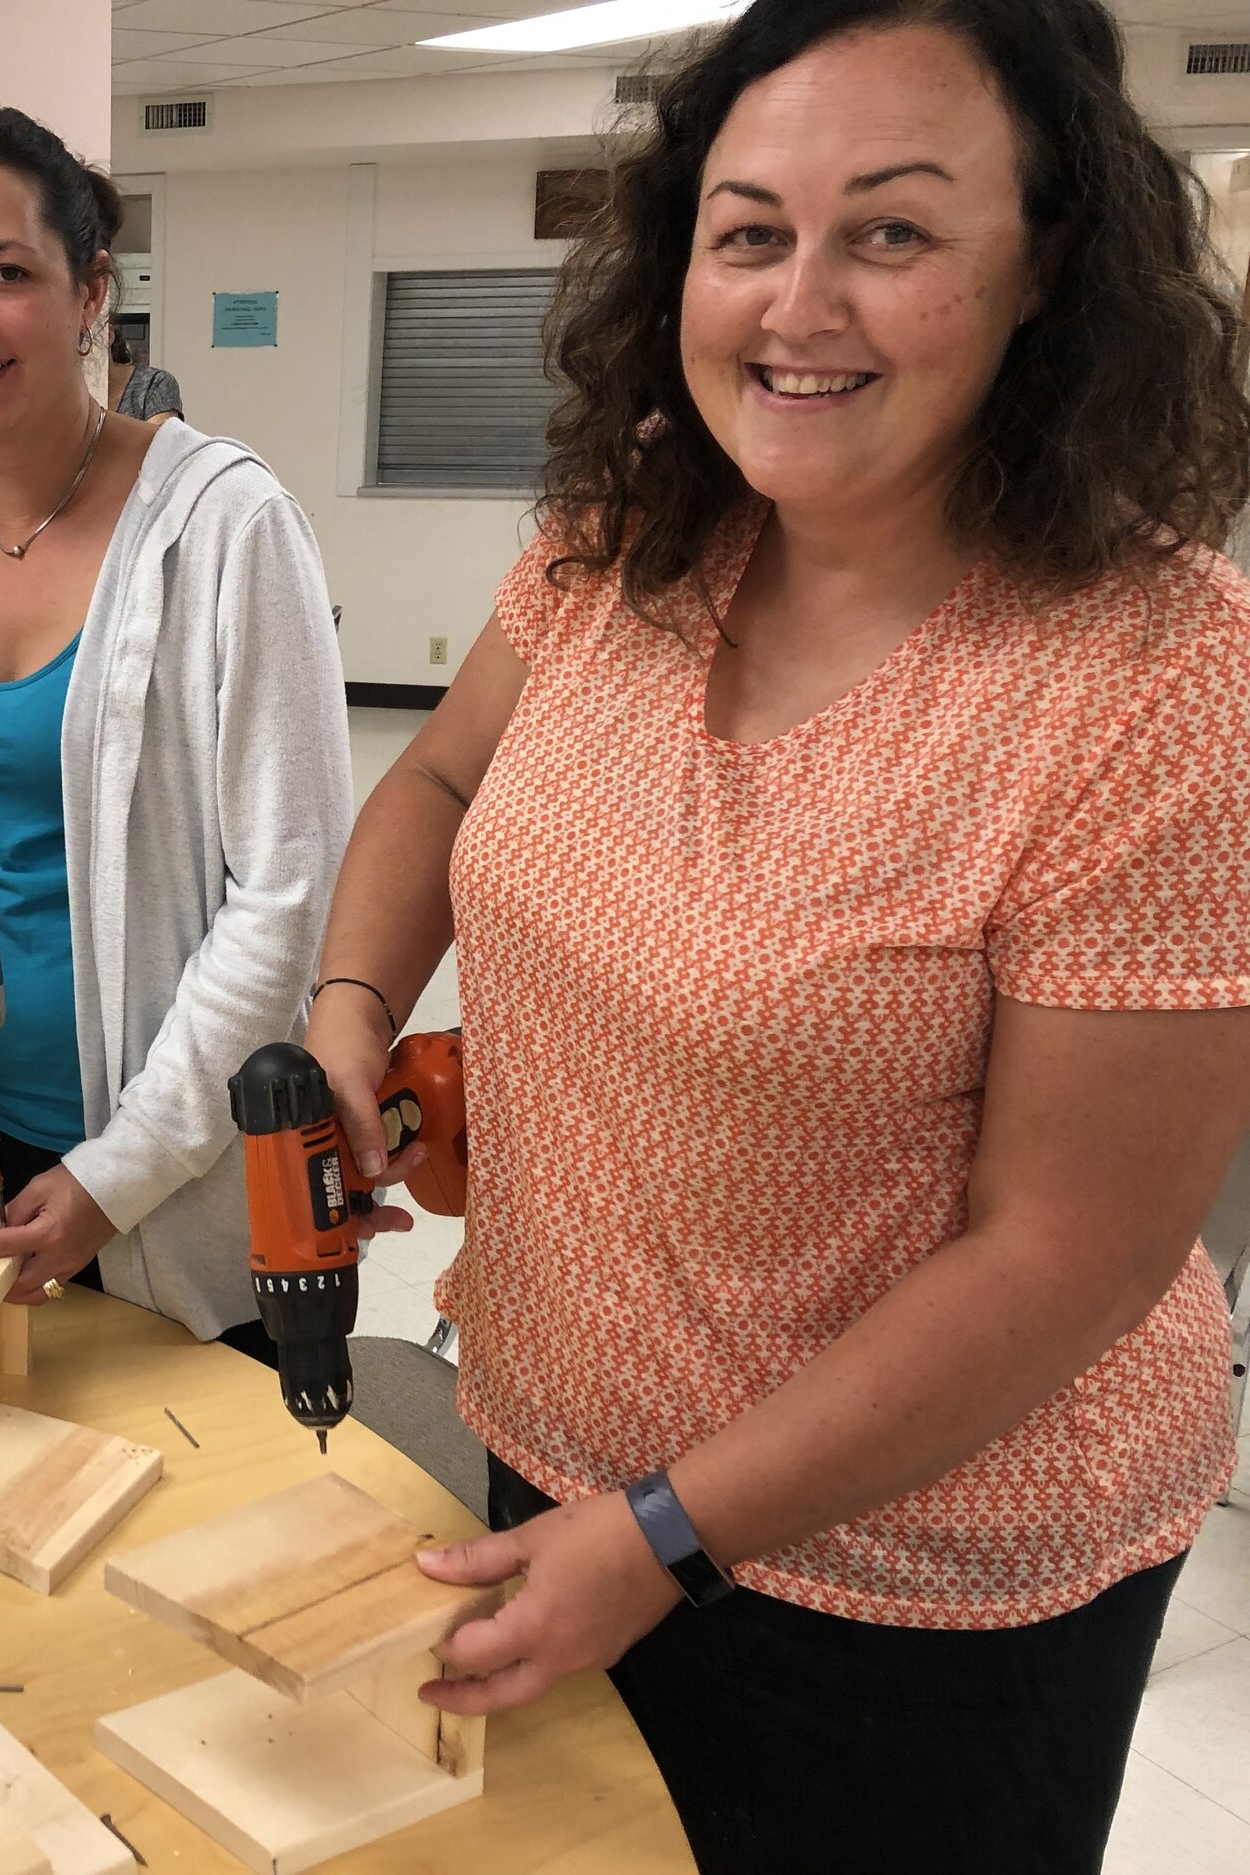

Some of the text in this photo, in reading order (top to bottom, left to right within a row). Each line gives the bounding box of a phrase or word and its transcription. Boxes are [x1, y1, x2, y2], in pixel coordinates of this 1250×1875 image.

[331, 1156, 344, 1205] DECKER
[266, 1273, 341, 1293] 1 2 3 4 5
